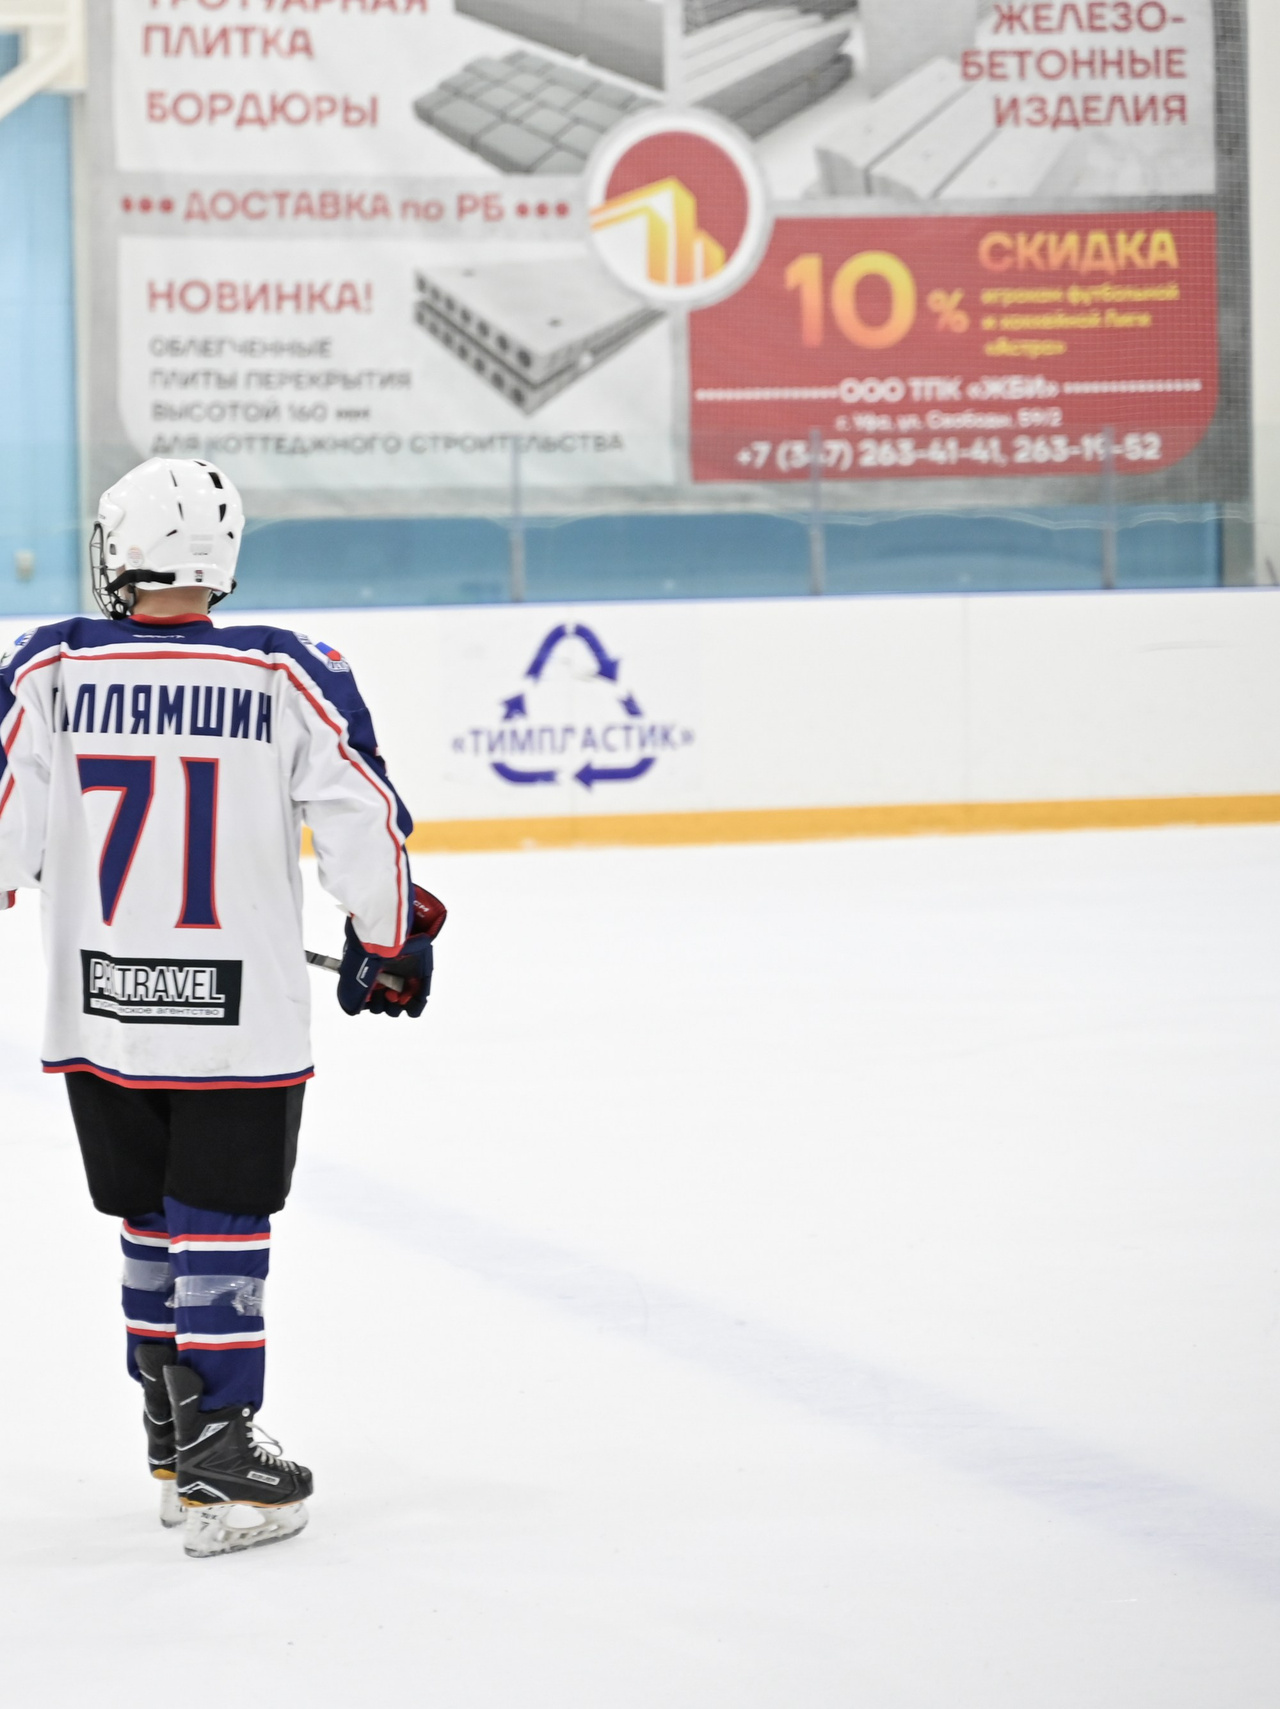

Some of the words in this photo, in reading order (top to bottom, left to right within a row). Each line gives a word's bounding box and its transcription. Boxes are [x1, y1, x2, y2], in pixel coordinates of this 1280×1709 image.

[992, 2, 1185, 35] ЖЕЛЕЗО-
[142, 25, 314, 58] ПЛИТКА
[961, 49, 1187, 81] БЕТОННЫЕ
[146, 91, 379, 128] БОРДЮРЫ
[993, 95, 1187, 129] ИЗДЕЛИЯ
[183, 190, 391, 222] ДОСТАВКА
[401, 200, 444, 222] по
[457, 193, 505, 222] РБ
[978, 231, 1179, 275] СКИДКА
[147, 281, 373, 314] НОВИНКА!
[784, 250, 918, 350] 10
[927, 289, 971, 333] %
[150, 369, 238, 391] ПЛИТЫ
[244, 368, 412, 390] ПЕРЕКРЫТИЯ
[839, 377, 906, 403] ООО
[151, 398, 281, 422] ВЫСОТОЙ
[288, 401, 328, 422] 160
[52, 683, 272, 743] ЛЛЯМШИН
[76, 754, 222, 929] 71
